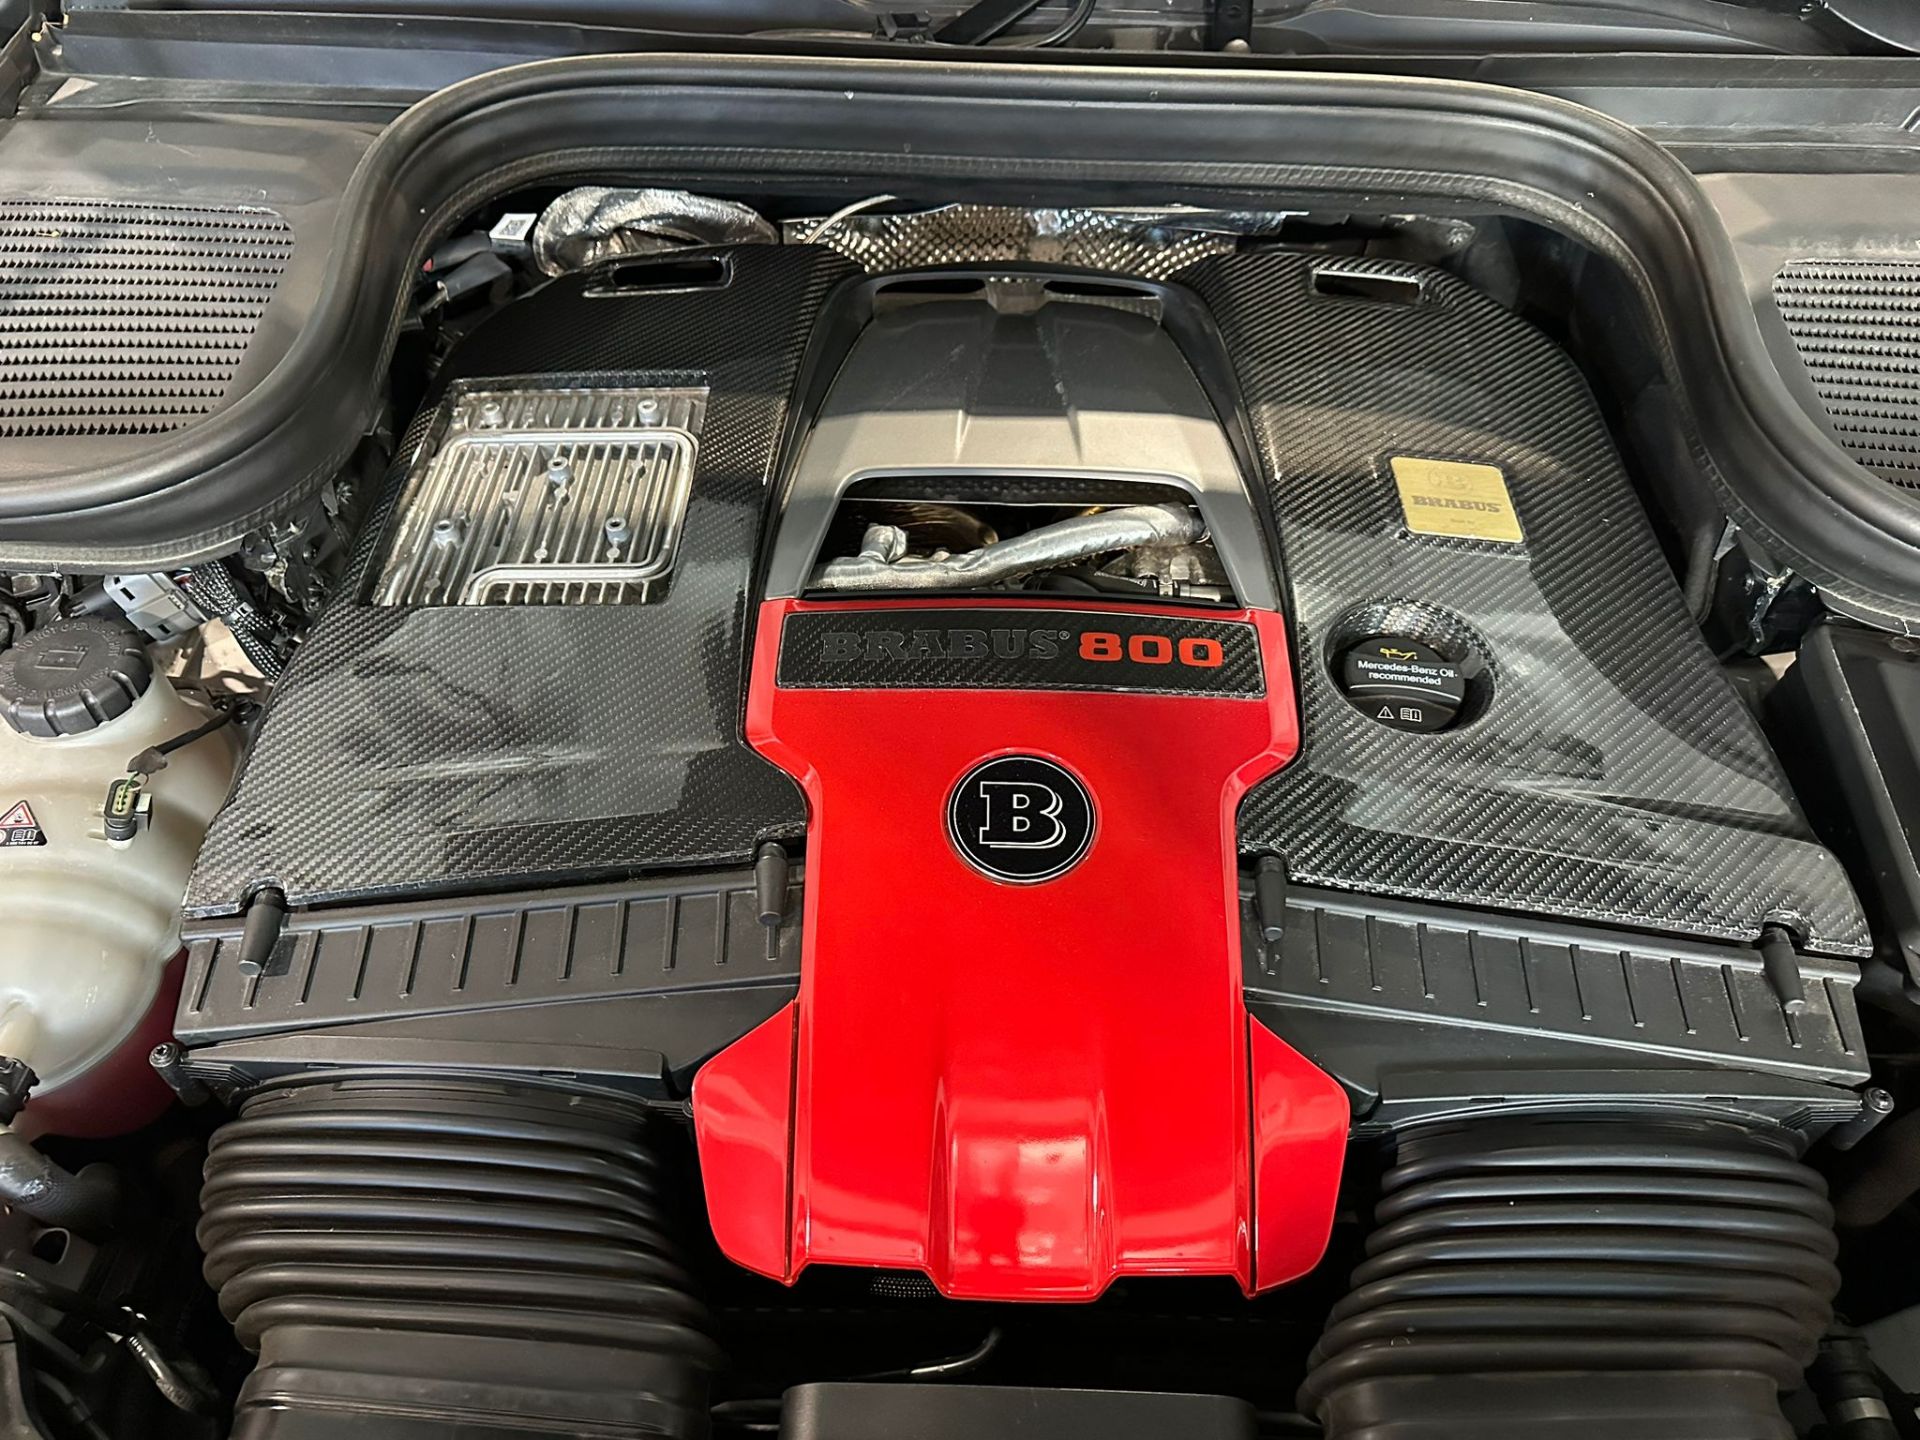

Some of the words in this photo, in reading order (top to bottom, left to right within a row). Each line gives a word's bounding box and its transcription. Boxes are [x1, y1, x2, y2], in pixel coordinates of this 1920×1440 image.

[1411, 495, 1502, 513] BRABUS
[1079, 631, 1223, 667] 800
[1357, 660, 1438, 676] Mercedes-Benz
[1368, 671, 1442, 686] recommended
[978, 781, 1067, 849] B
